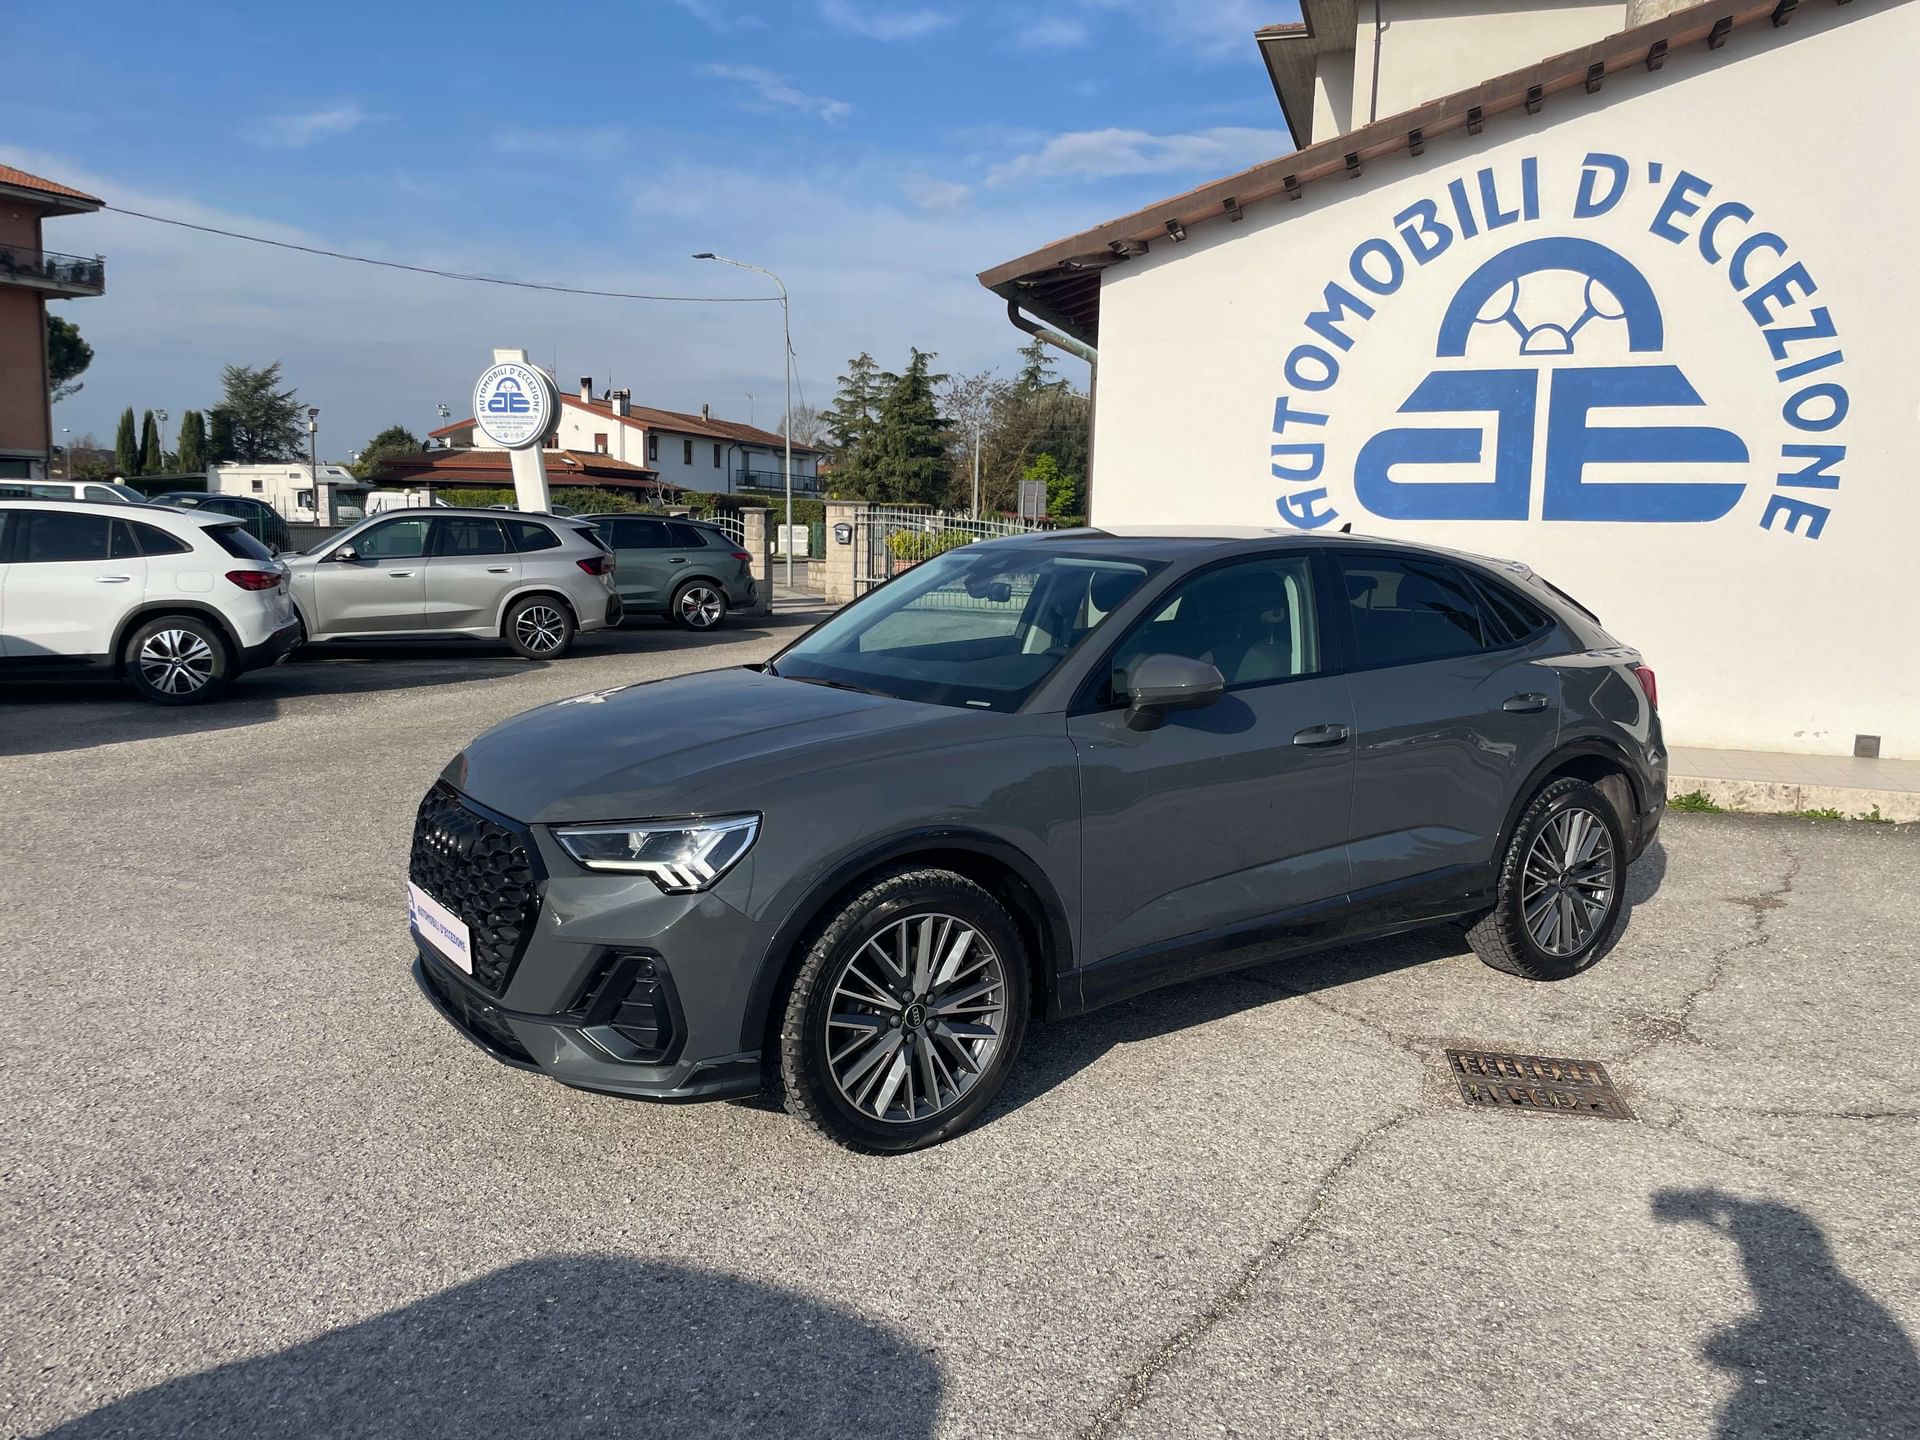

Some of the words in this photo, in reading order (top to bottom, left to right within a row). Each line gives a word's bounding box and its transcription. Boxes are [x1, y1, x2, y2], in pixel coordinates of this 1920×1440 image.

[479, 368, 507, 412] AUTOMOBILI
[509, 367, 540, 414] D'ECCEZIONE
[1271, 156, 1540, 529] AUTOMOBILI
[1573, 152, 1850, 540] D'ECCEZIONE
